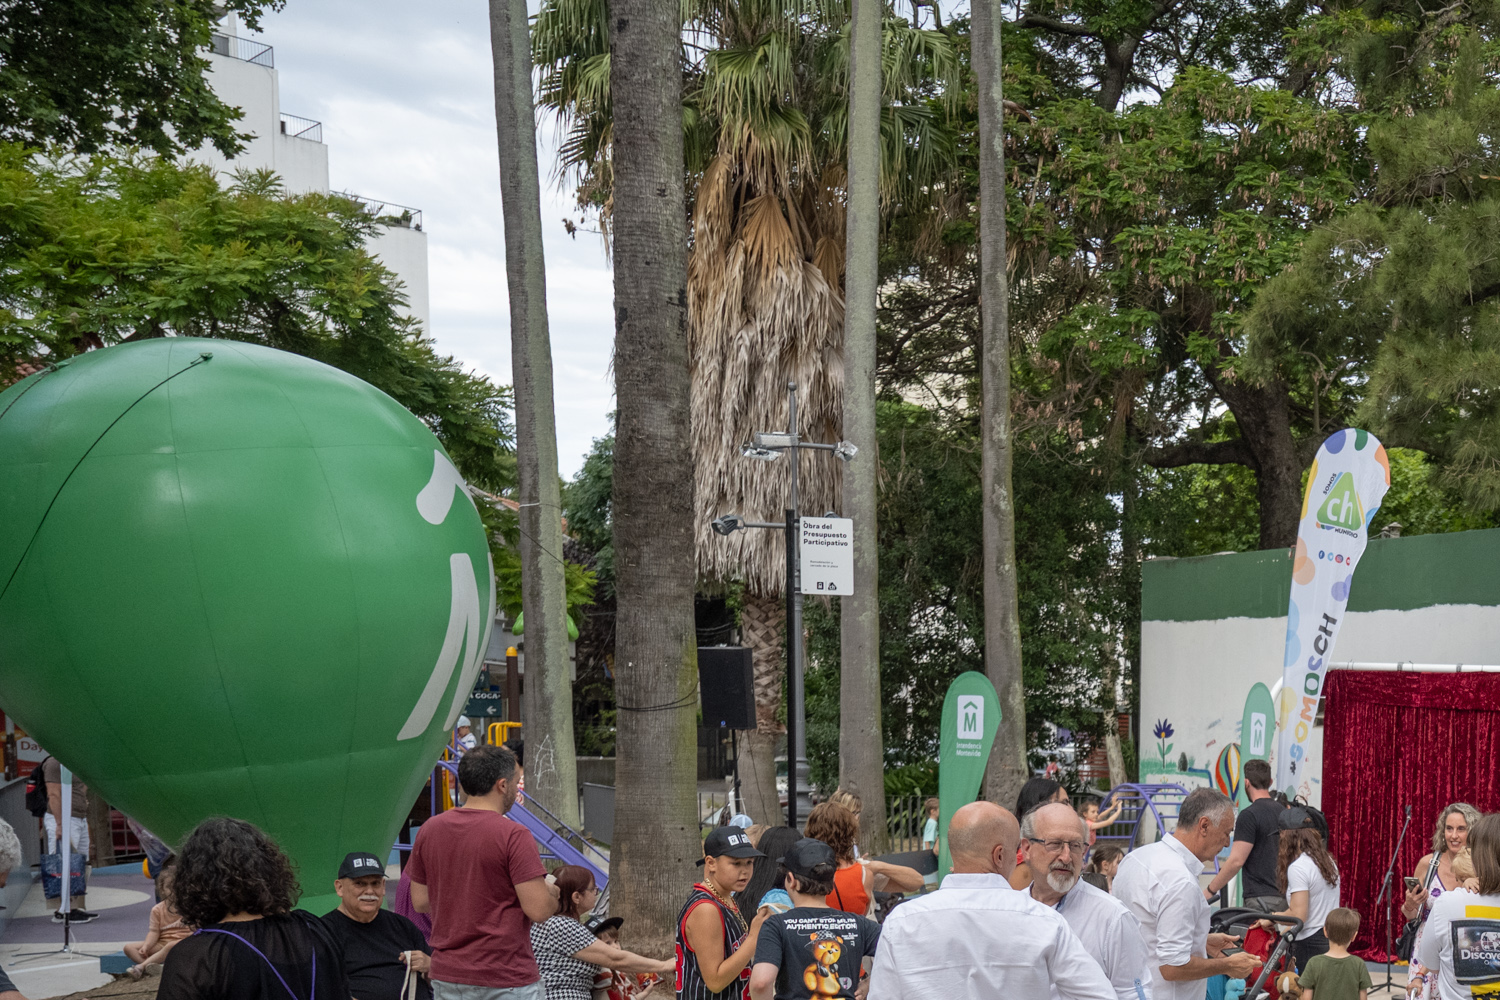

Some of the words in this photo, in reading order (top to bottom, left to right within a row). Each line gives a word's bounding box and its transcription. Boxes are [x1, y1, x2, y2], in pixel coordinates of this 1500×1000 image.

[1322, 473, 1337, 495] SOMOS
[1326, 490, 1353, 525] ch
[803, 539, 848, 547] Participativo
[964, 712, 976, 732] M
